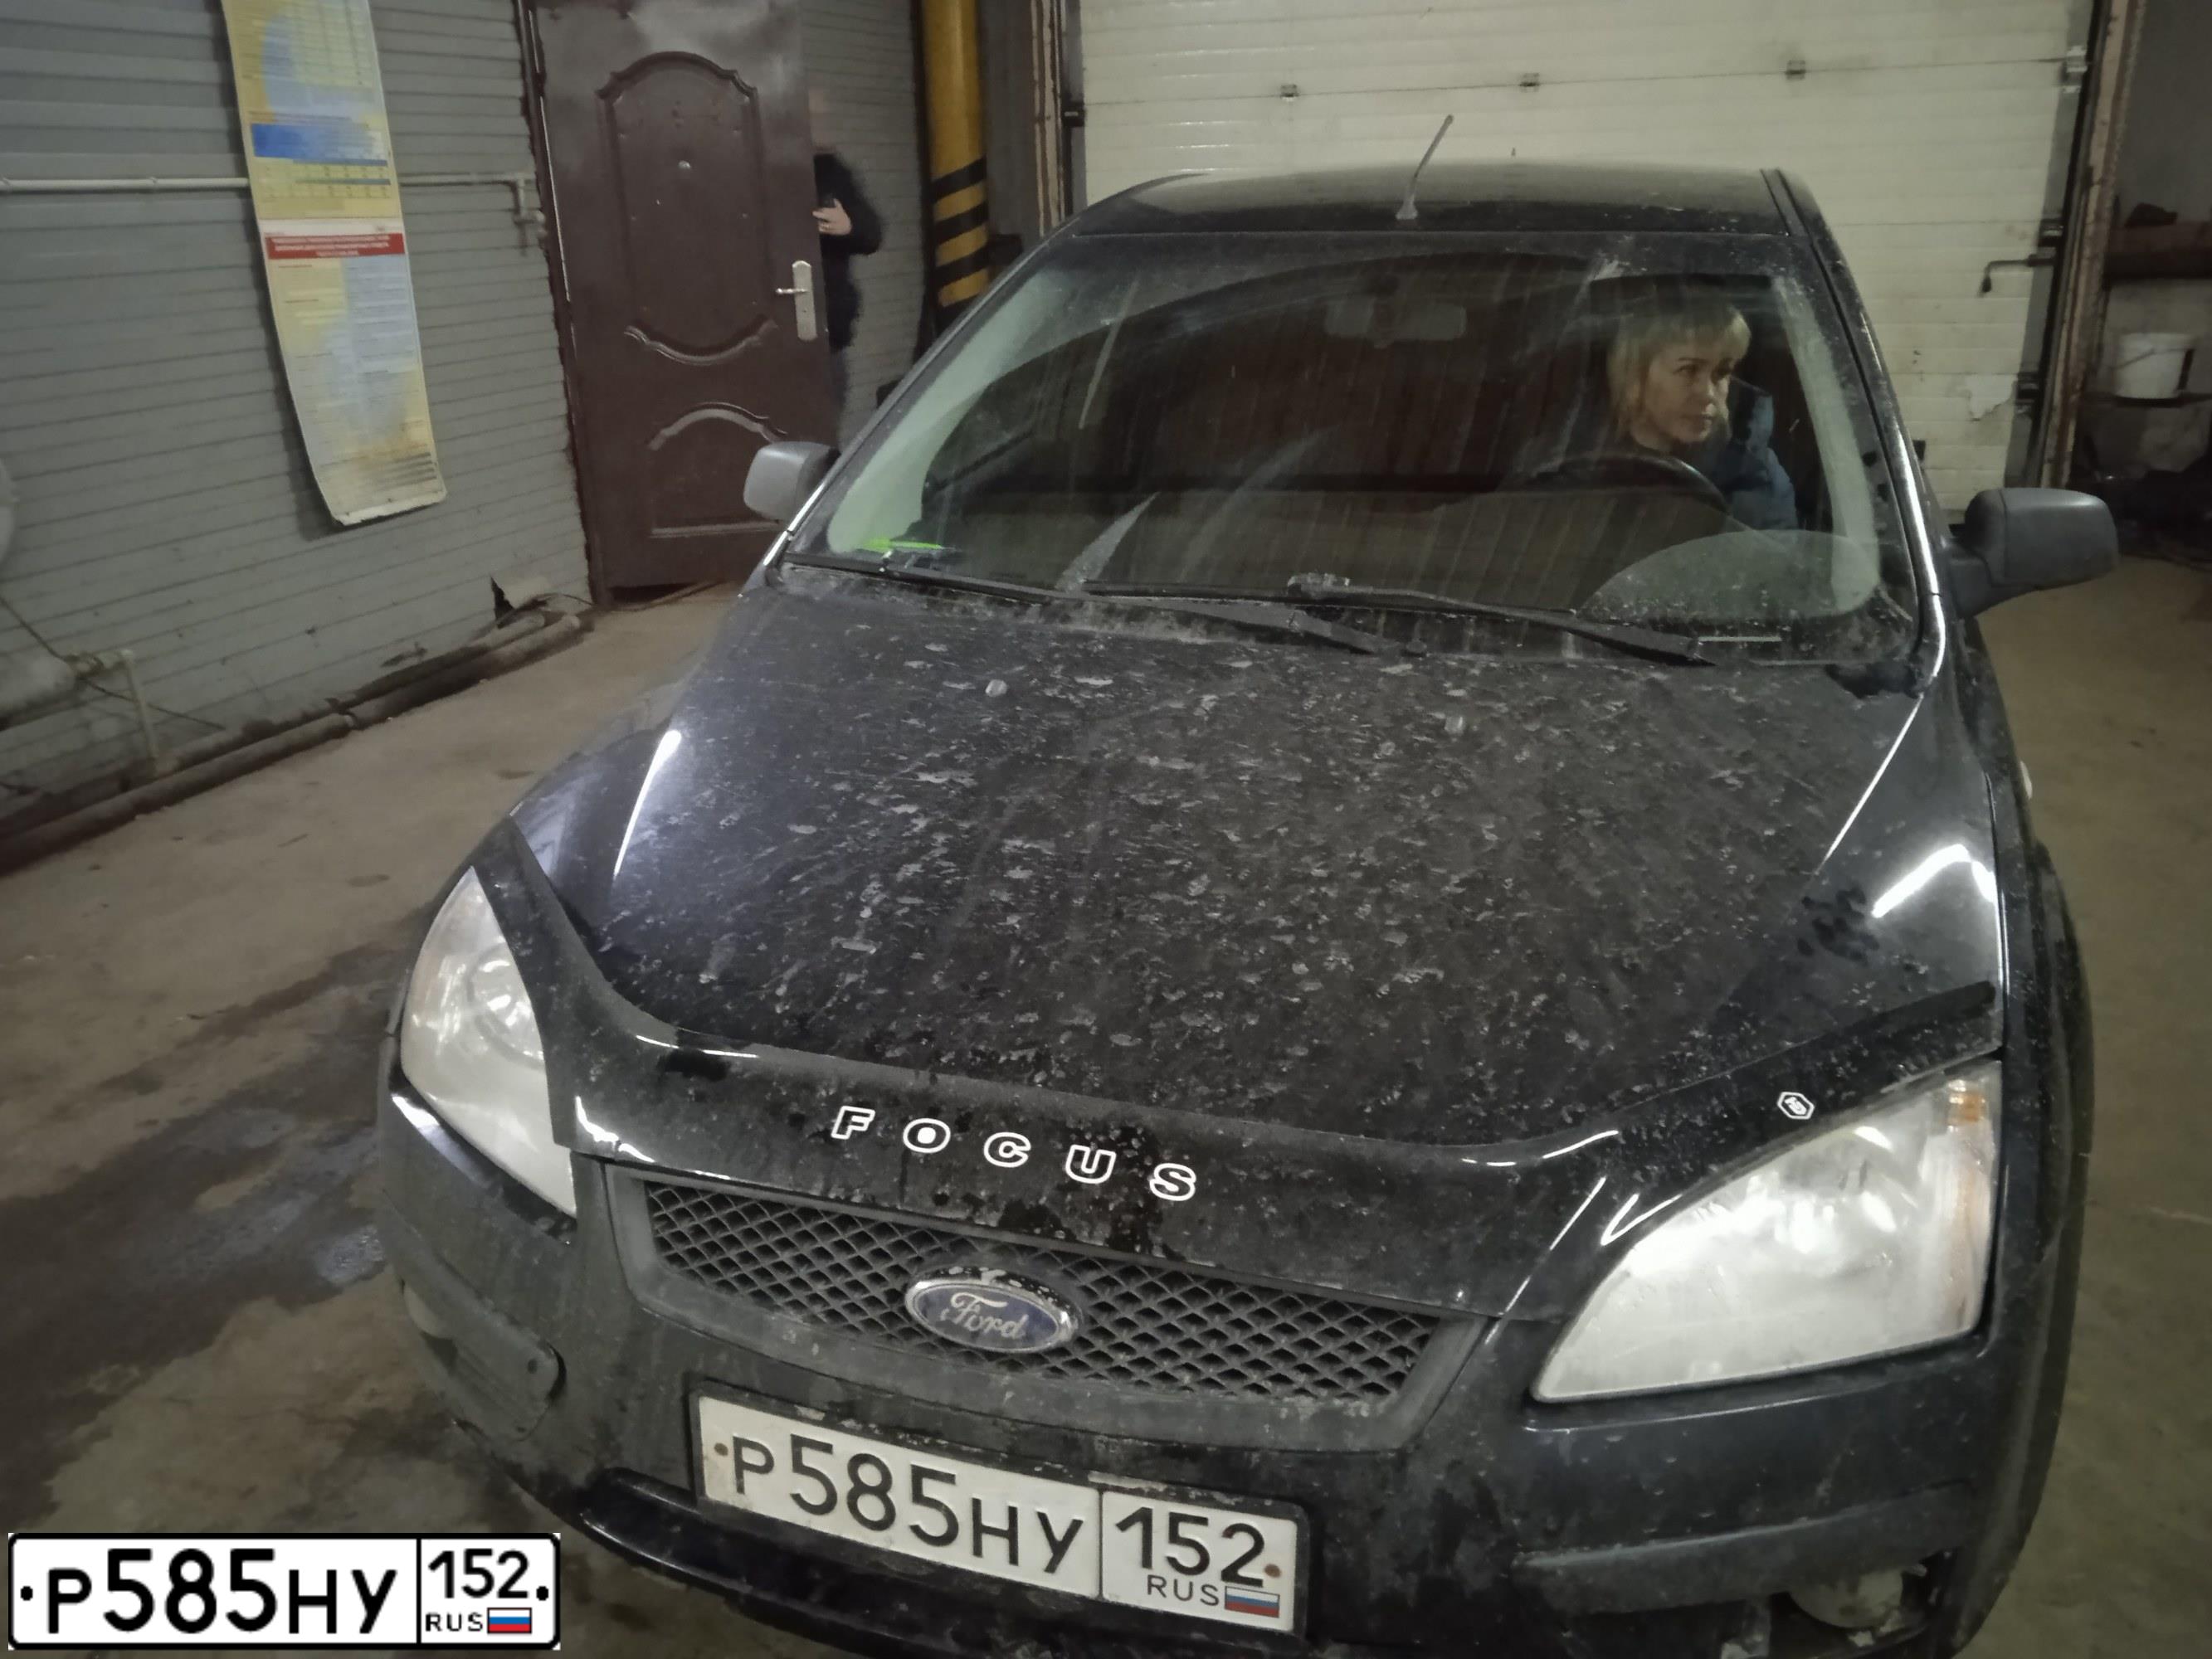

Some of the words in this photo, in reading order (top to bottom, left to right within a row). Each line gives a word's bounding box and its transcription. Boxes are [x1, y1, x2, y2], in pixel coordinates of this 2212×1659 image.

[831, 1106, 1196, 1201] FOCUS
[938, 1292, 1030, 1339] Ford
[1116, 1506, 1266, 1588] 152
[1147, 1574, 1220, 1608] RUS
